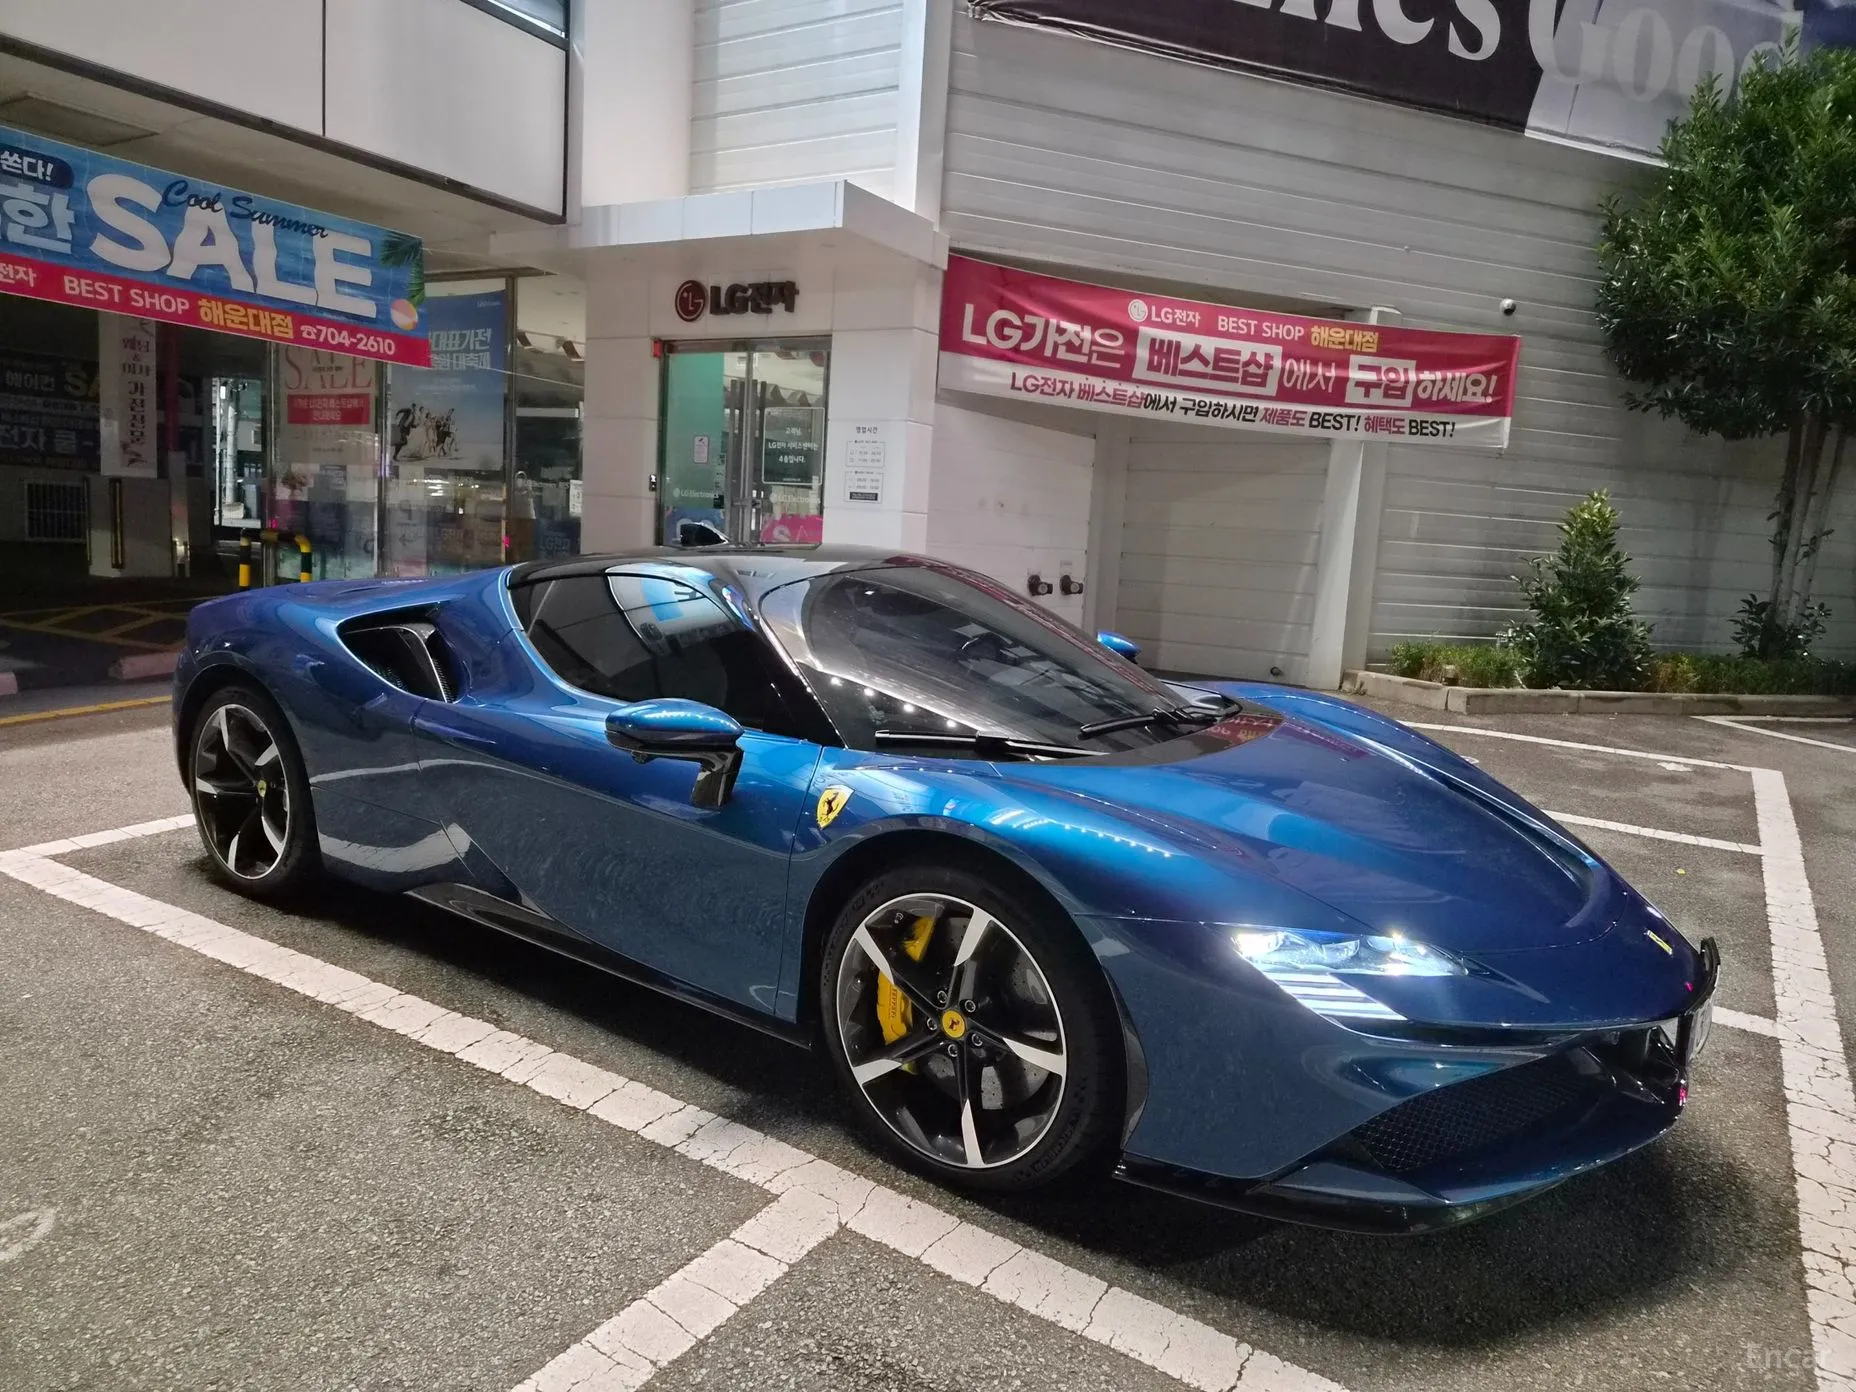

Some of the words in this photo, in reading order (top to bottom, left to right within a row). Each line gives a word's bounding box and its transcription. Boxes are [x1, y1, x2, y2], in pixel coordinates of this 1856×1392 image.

[163, 179, 223, 214] Cool
[230, 195, 330, 240] Summer
[87, 174, 378, 318] SALE
[64, 275, 132, 304] BEST
[130, 288, 190, 316] SHOP
[199, 298, 295, 339] 해운대점
[708, 279, 801, 316] LG전자
[1151, 305, 1201, 328] LG전자
[1217, 316, 1257, 335] BEST
[1262, 321, 1305, 341] SHOP
[1310, 325, 1380, 353] 해운대점
[962, 303, 1126, 369] LG가전은
[1010, 371, 1075, 399] LG전자
[1077, 382, 1176, 414] 베스트샵에서
[1178, 398, 1259, 424] 구입하시면
[1259, 407, 1309, 428] 제품도
[1308, 412, 1361, 432] BEST!
[1364, 414, 1406, 435] 혜택도
[1408, 417, 1456, 438] BEST!
